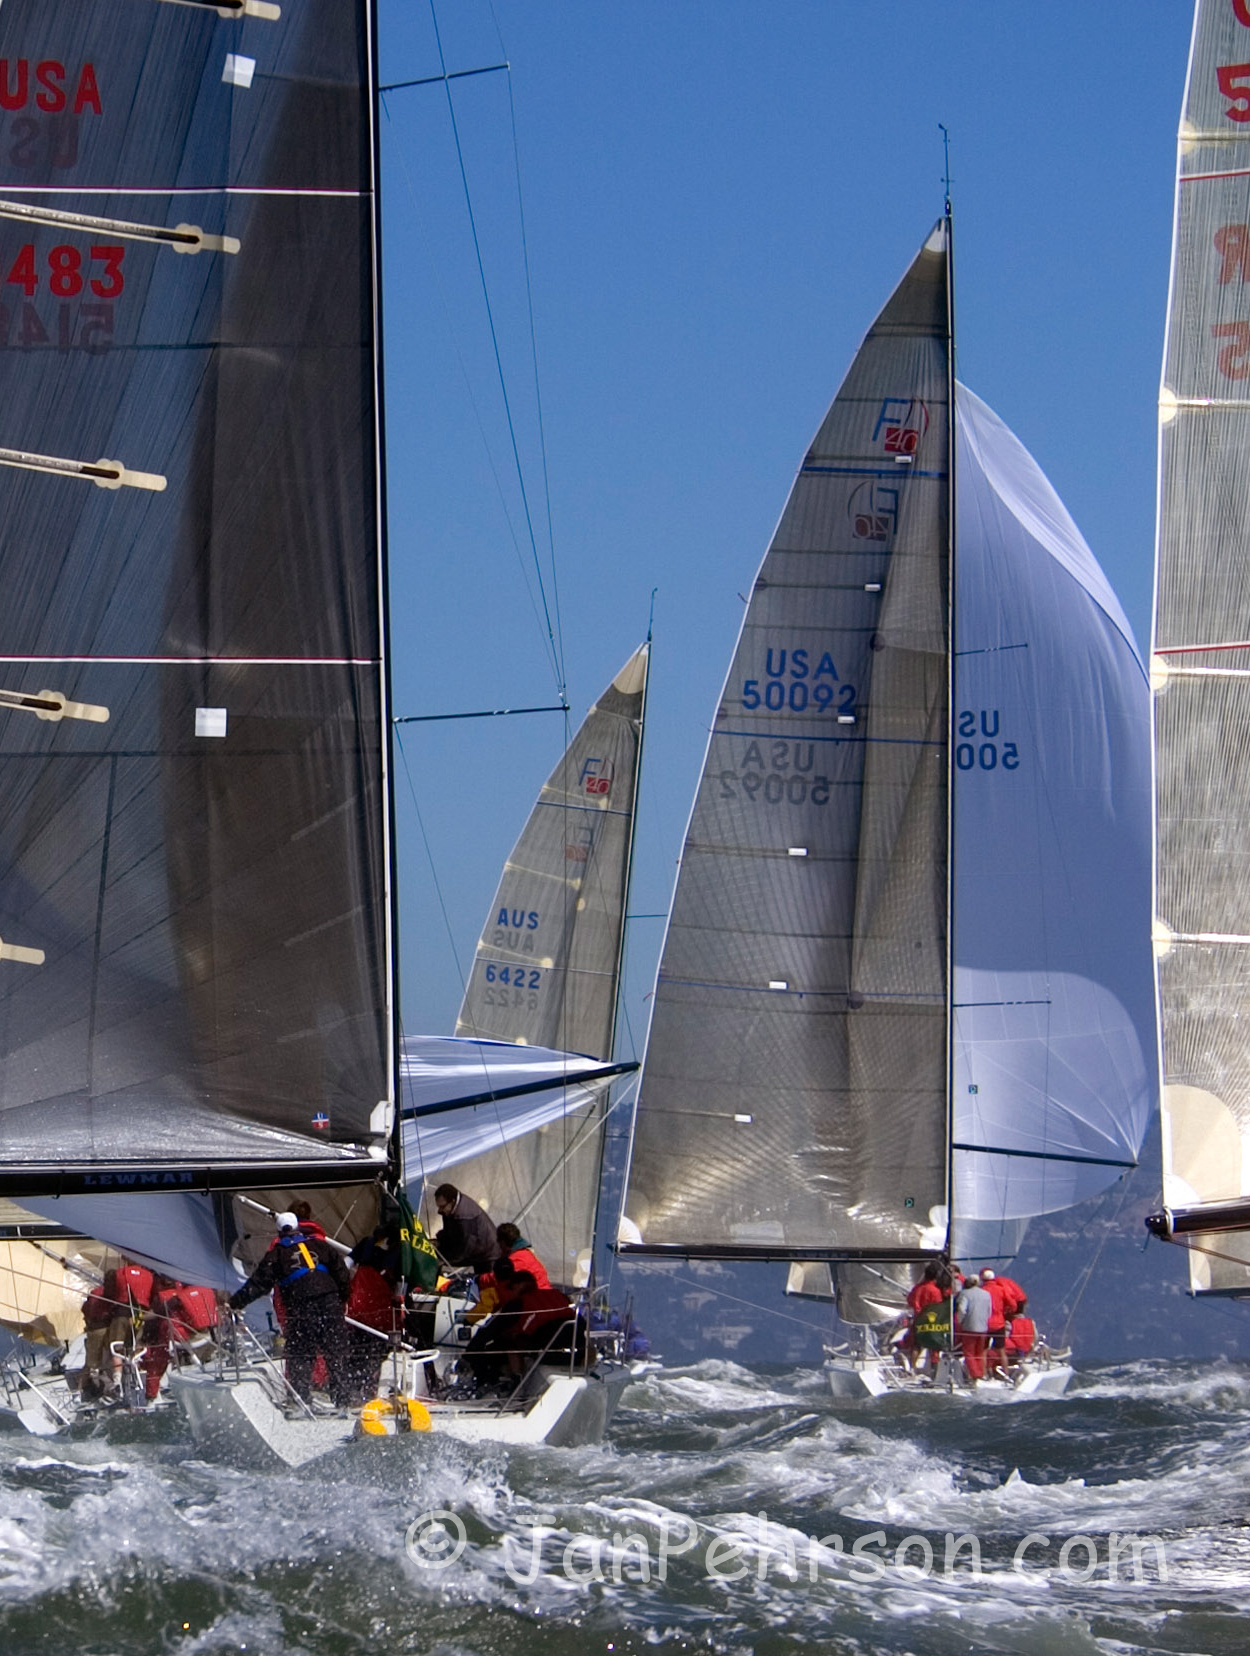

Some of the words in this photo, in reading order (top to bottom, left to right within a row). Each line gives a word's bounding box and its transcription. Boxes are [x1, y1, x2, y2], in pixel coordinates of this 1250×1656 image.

[766, 648, 839, 682] USA
[742, 680, 857, 714] 50092
[497, 908, 539, 930] AUS
[486, 964, 540, 989] 6422
[84, 1171, 193, 1185] LEWMAR
[399, 1228, 438, 1260] RLEX
